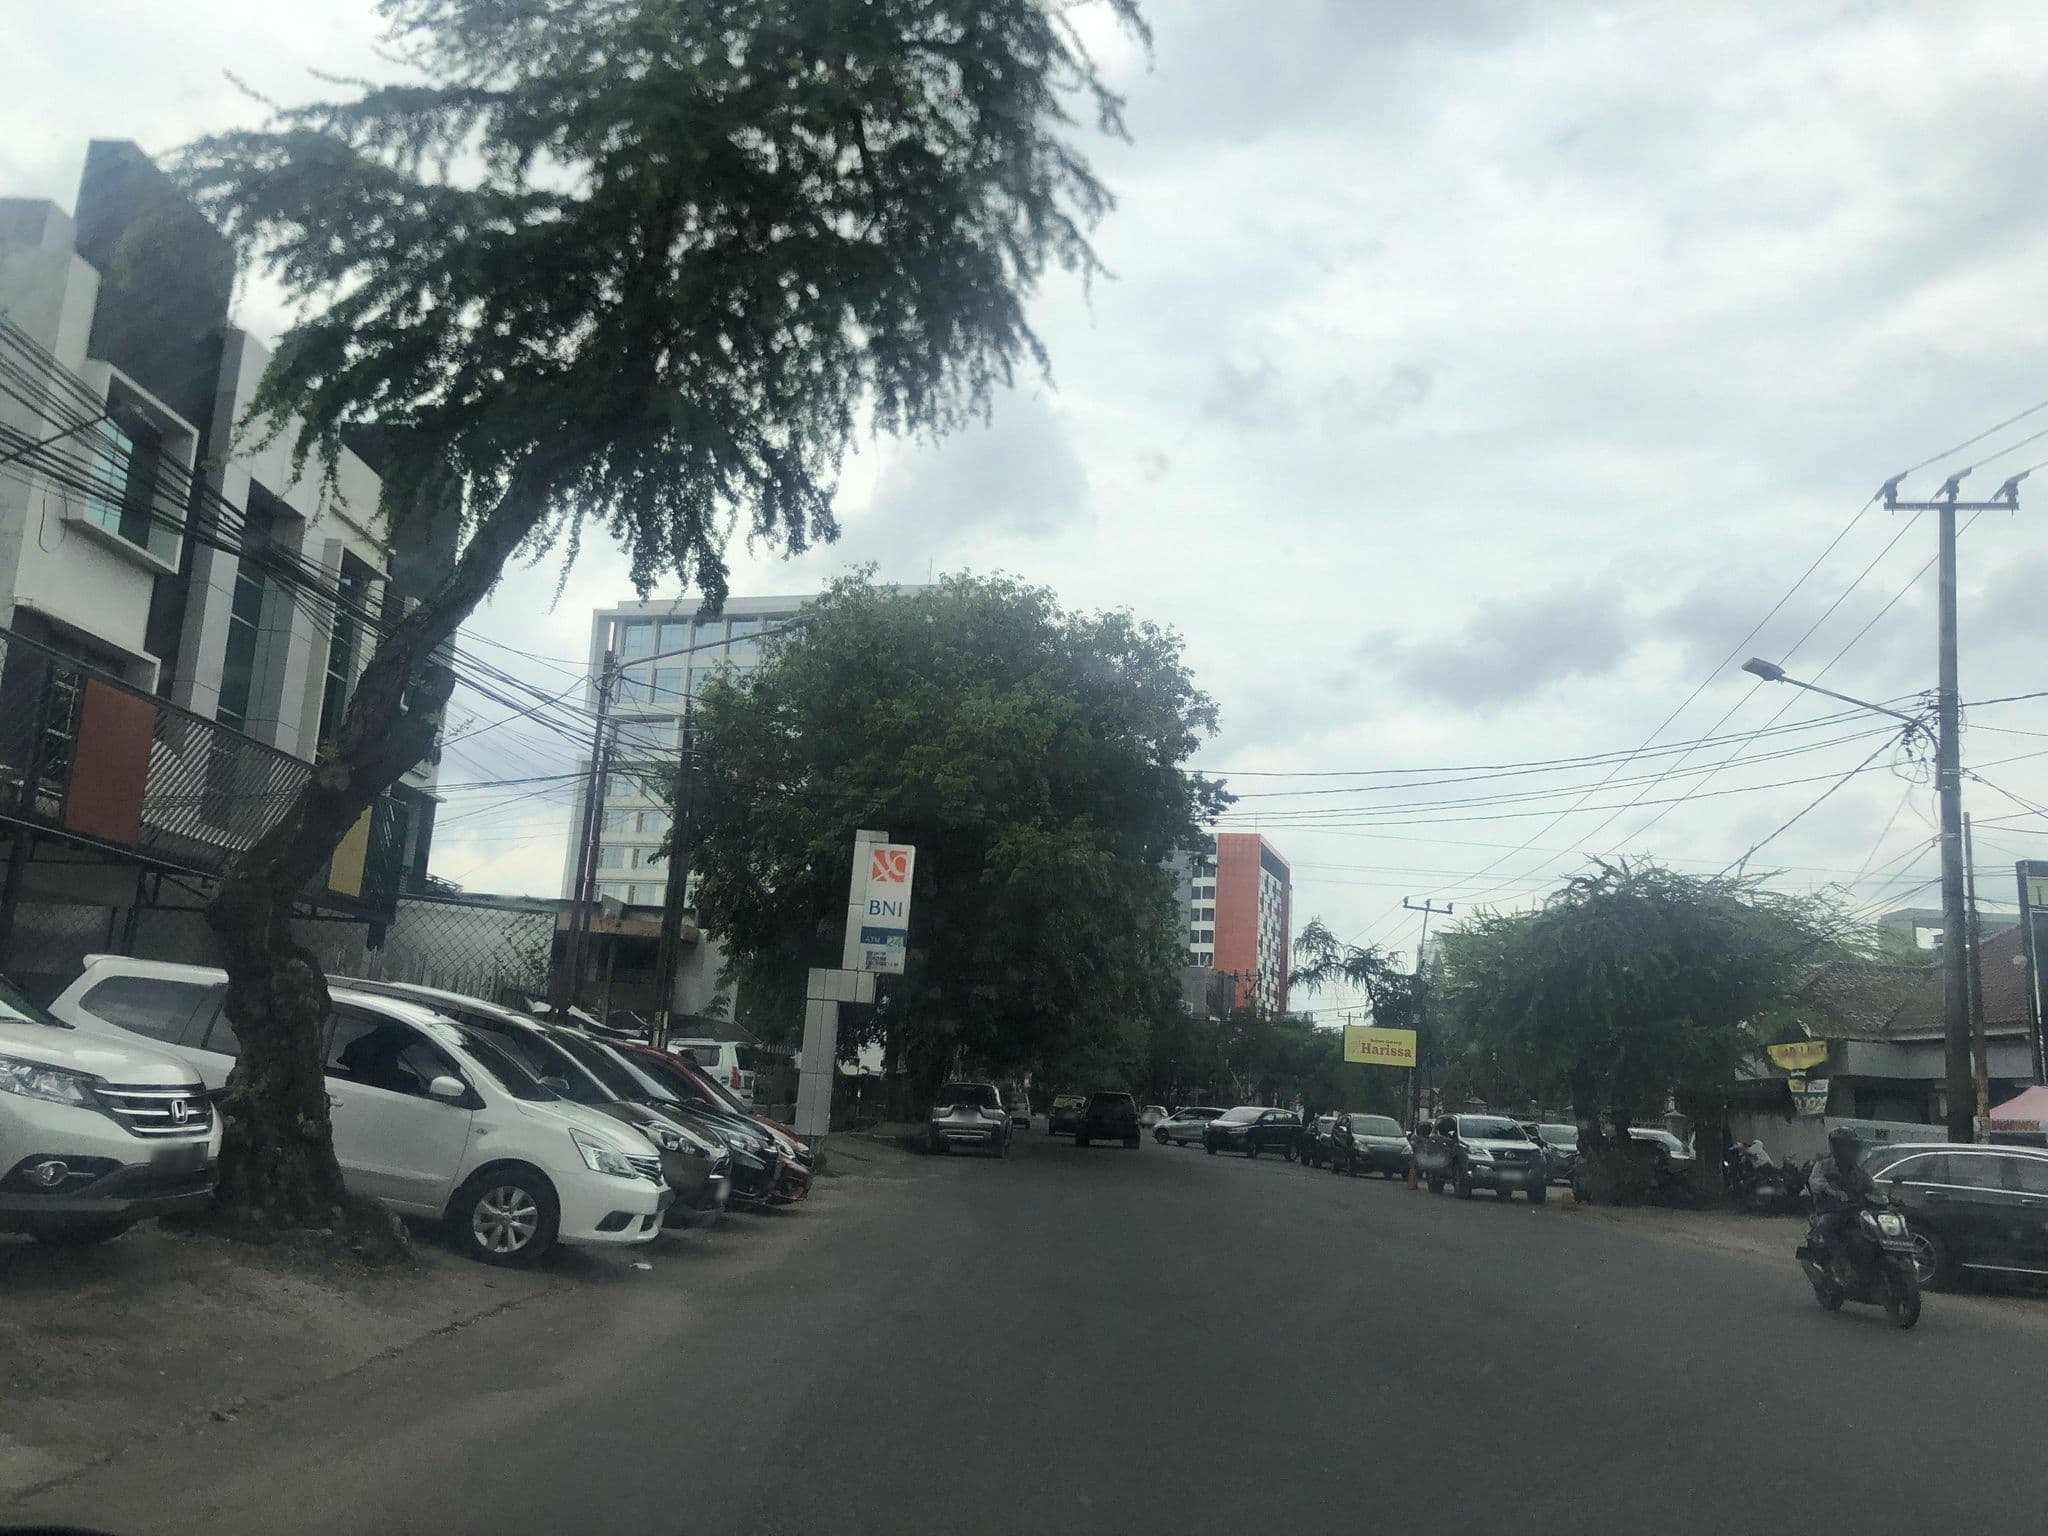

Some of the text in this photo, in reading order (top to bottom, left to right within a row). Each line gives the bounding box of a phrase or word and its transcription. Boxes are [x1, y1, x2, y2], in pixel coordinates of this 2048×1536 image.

[869, 900, 902, 917] BNI
[865, 935, 881, 943] ATM
[1361, 1043, 1411, 1057] Harissa
